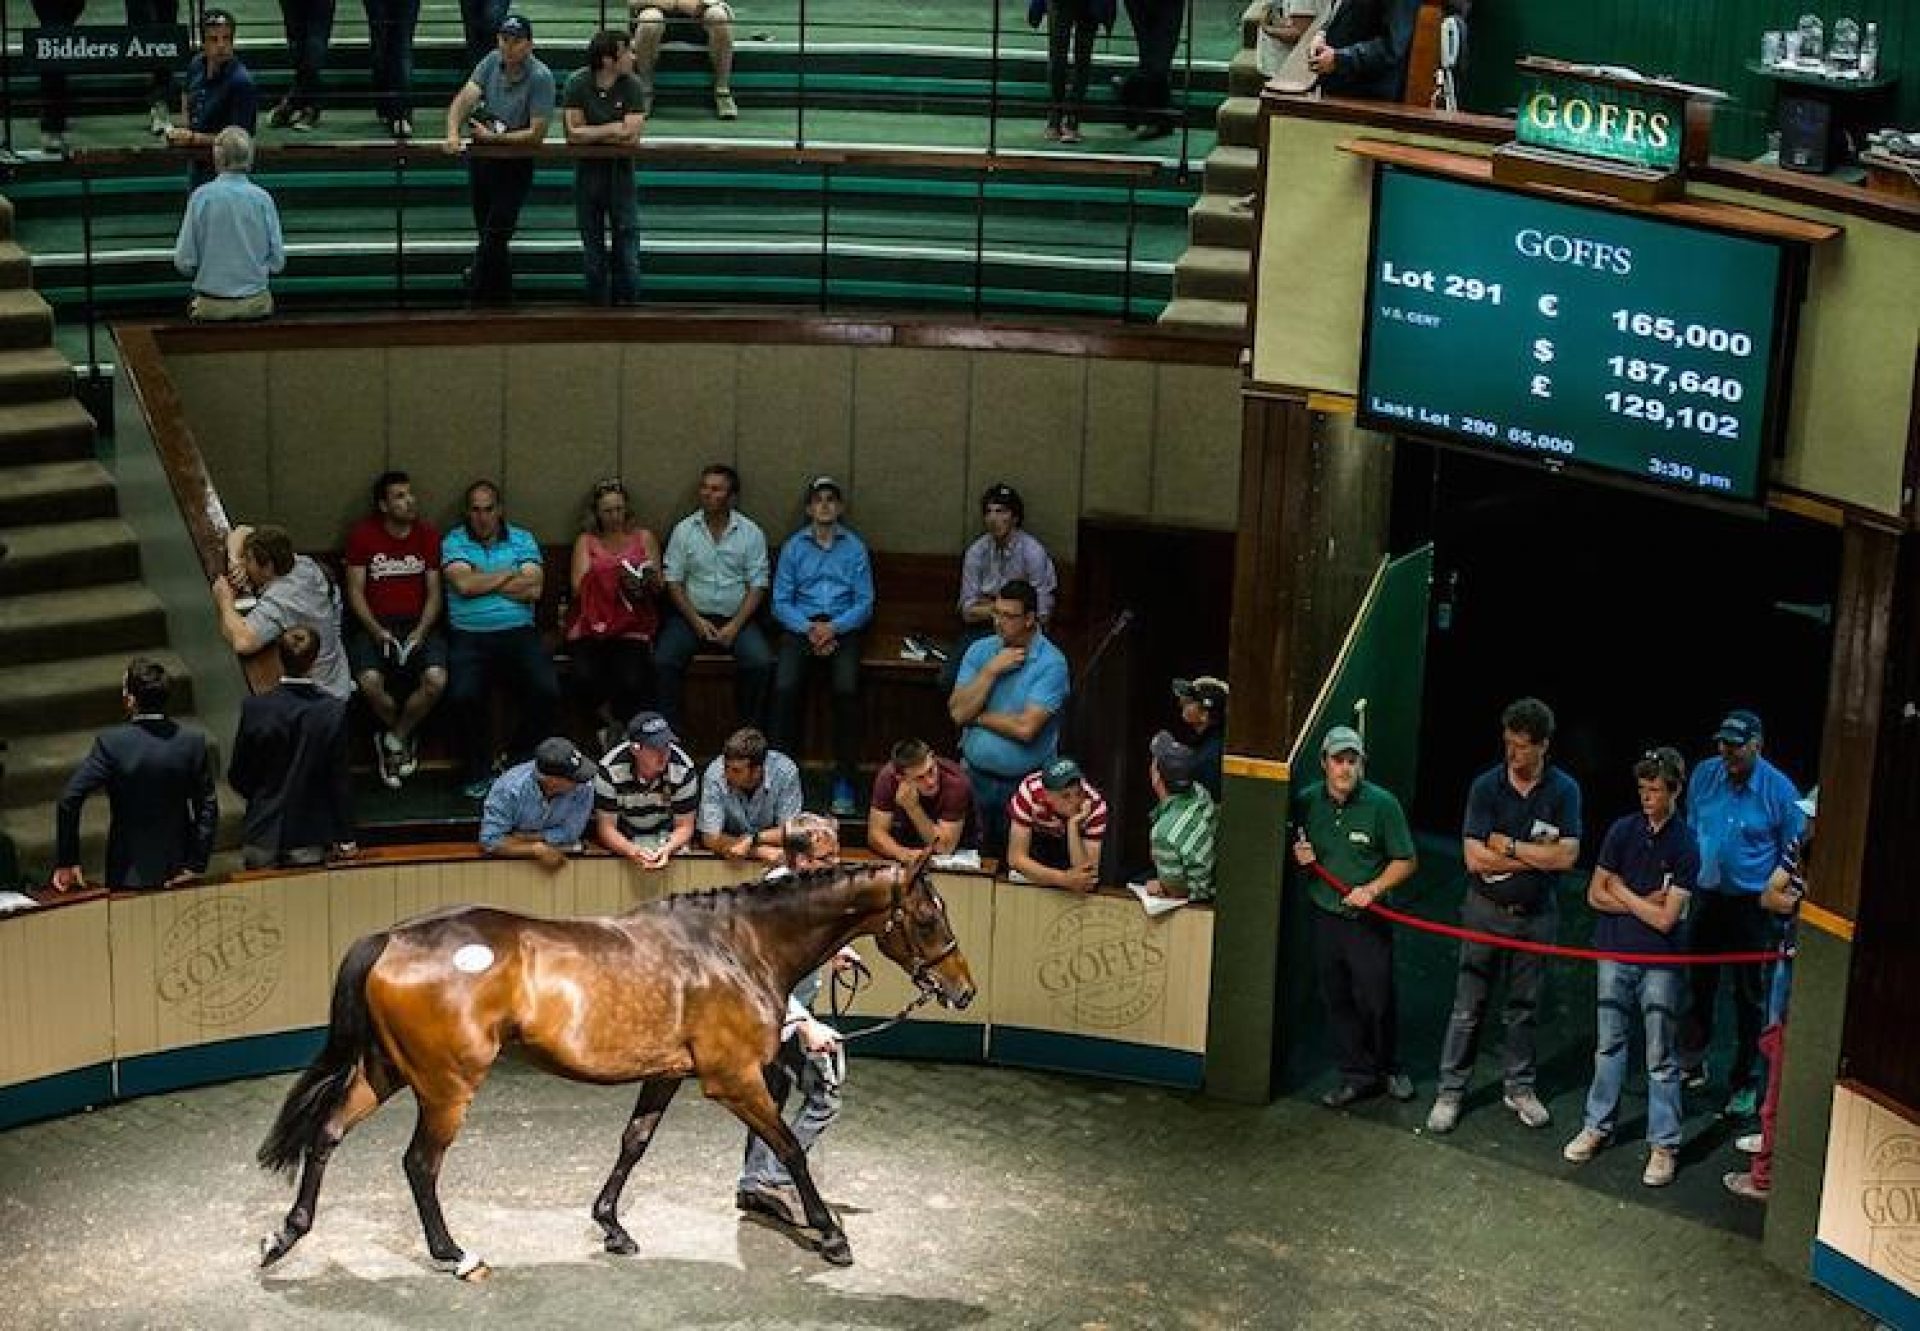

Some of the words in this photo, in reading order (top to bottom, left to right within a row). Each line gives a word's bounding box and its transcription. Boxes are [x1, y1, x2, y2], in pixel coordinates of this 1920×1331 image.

[36, 36, 119, 59] Bidders
[126, 36, 178, 57] Area
[1528, 94, 1670, 147] GOFFS
[1515, 229, 1632, 275] GOFFS
[1382, 261, 1436, 292] Lot
[1444, 274, 1502, 305] 291
[1538, 294, 1558, 317] €
[1612, 309, 1751, 357] 165,000
[1532, 338, 1555, 363] $
[1608, 355, 1743, 402] 187,640
[1371, 396, 1414, 420] Last
[1420, 408, 1450, 427] Lot
[1461, 416, 1498, 437] 290
[1530, 374, 1551, 398] £
[1604, 391, 1739, 439] 129,102
[1648, 457, 1693, 481] 3:30
[1699, 472, 1732, 490] pm
[156, 923, 281, 1002] GOFFS
[1038, 940, 1163, 991] GOFFS
